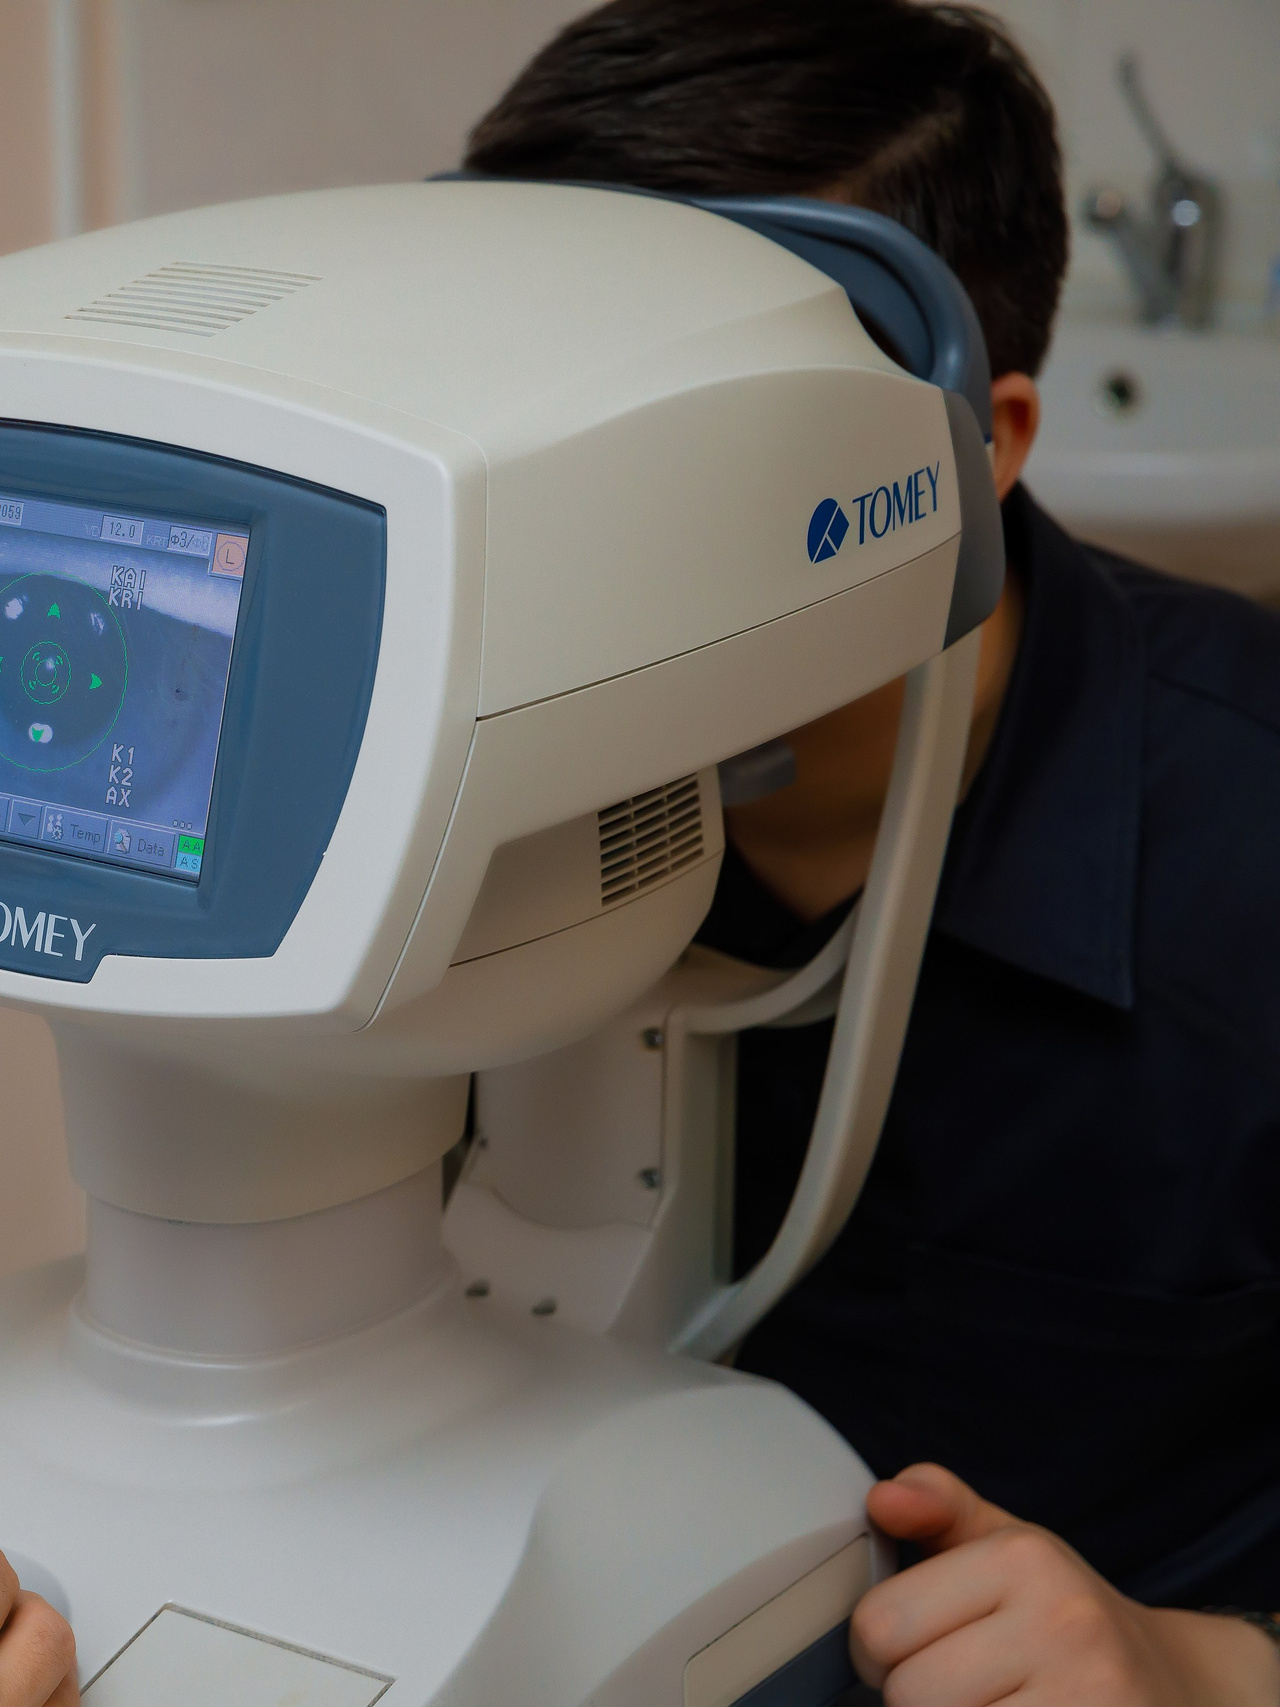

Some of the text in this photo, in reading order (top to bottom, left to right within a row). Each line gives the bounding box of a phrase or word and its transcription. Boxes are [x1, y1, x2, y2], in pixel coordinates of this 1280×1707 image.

[852, 460, 940, 546] TOMEY
[110, 521, 136, 538] 12.0
[225, 548, 235, 565] L
[111, 743, 135, 765] K1
[108, 764, 134, 787] K2
[105, 786, 132, 808] AX
[70, 824, 101, 844] Temp
[138, 838, 165, 857] Data
